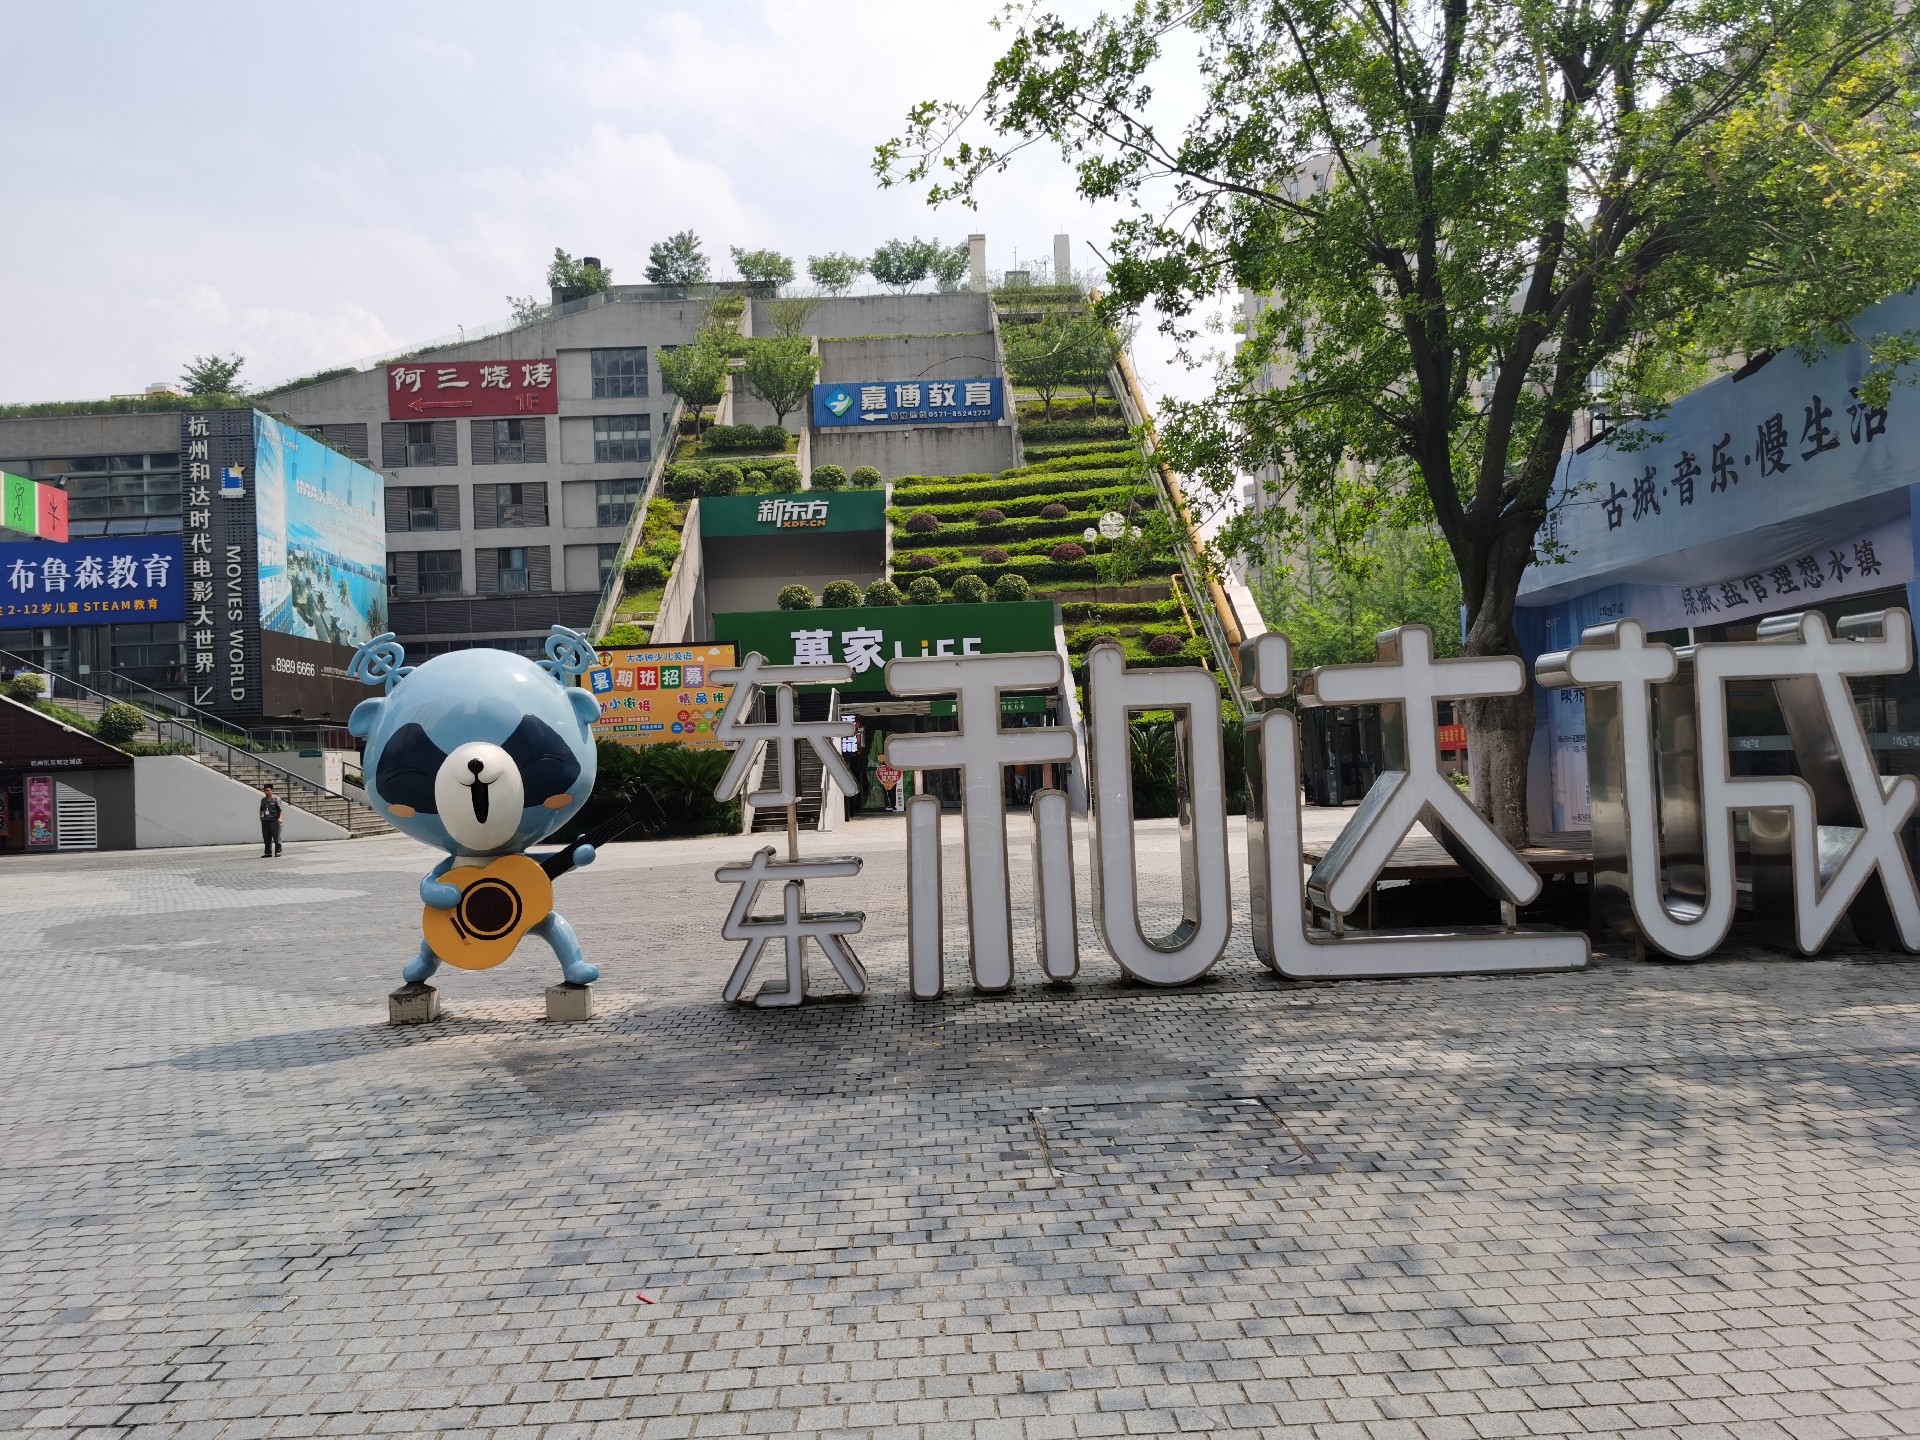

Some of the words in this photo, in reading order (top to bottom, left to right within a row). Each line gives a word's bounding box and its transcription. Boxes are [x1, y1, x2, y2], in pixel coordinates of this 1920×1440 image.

[391, 363, 553, 393] 阿三烧烤
[515, 393, 539, 411] 1F
[860, 382, 991, 411] 嘉博教育
[757, 498, 829, 528] 新东方
[782, 519, 827, 528] XDF.CN
[188, 416, 215, 673] 杭州和达时代电影大世界
[7, 554, 173, 594] 布鲁森教育
[226, 546, 243, 621] MOVIES
[229, 629, 245, 701] WORLD
[790, 627, 887, 673] 萬家
[593, 667, 703, 691] 暑期班招募
